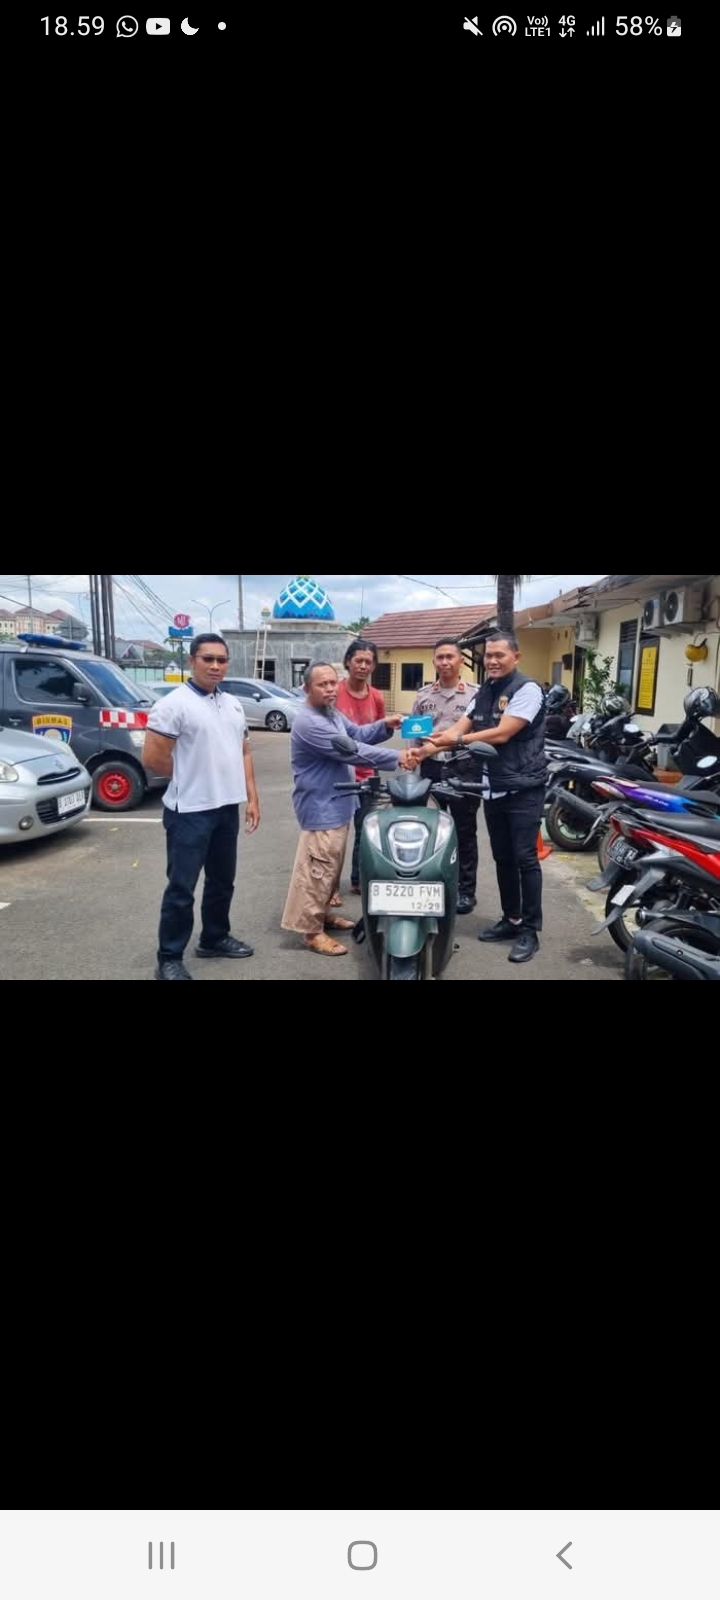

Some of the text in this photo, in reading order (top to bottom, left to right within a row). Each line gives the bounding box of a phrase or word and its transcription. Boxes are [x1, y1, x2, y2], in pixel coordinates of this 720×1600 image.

[372, 884, 441, 897] B 5220 FVM
